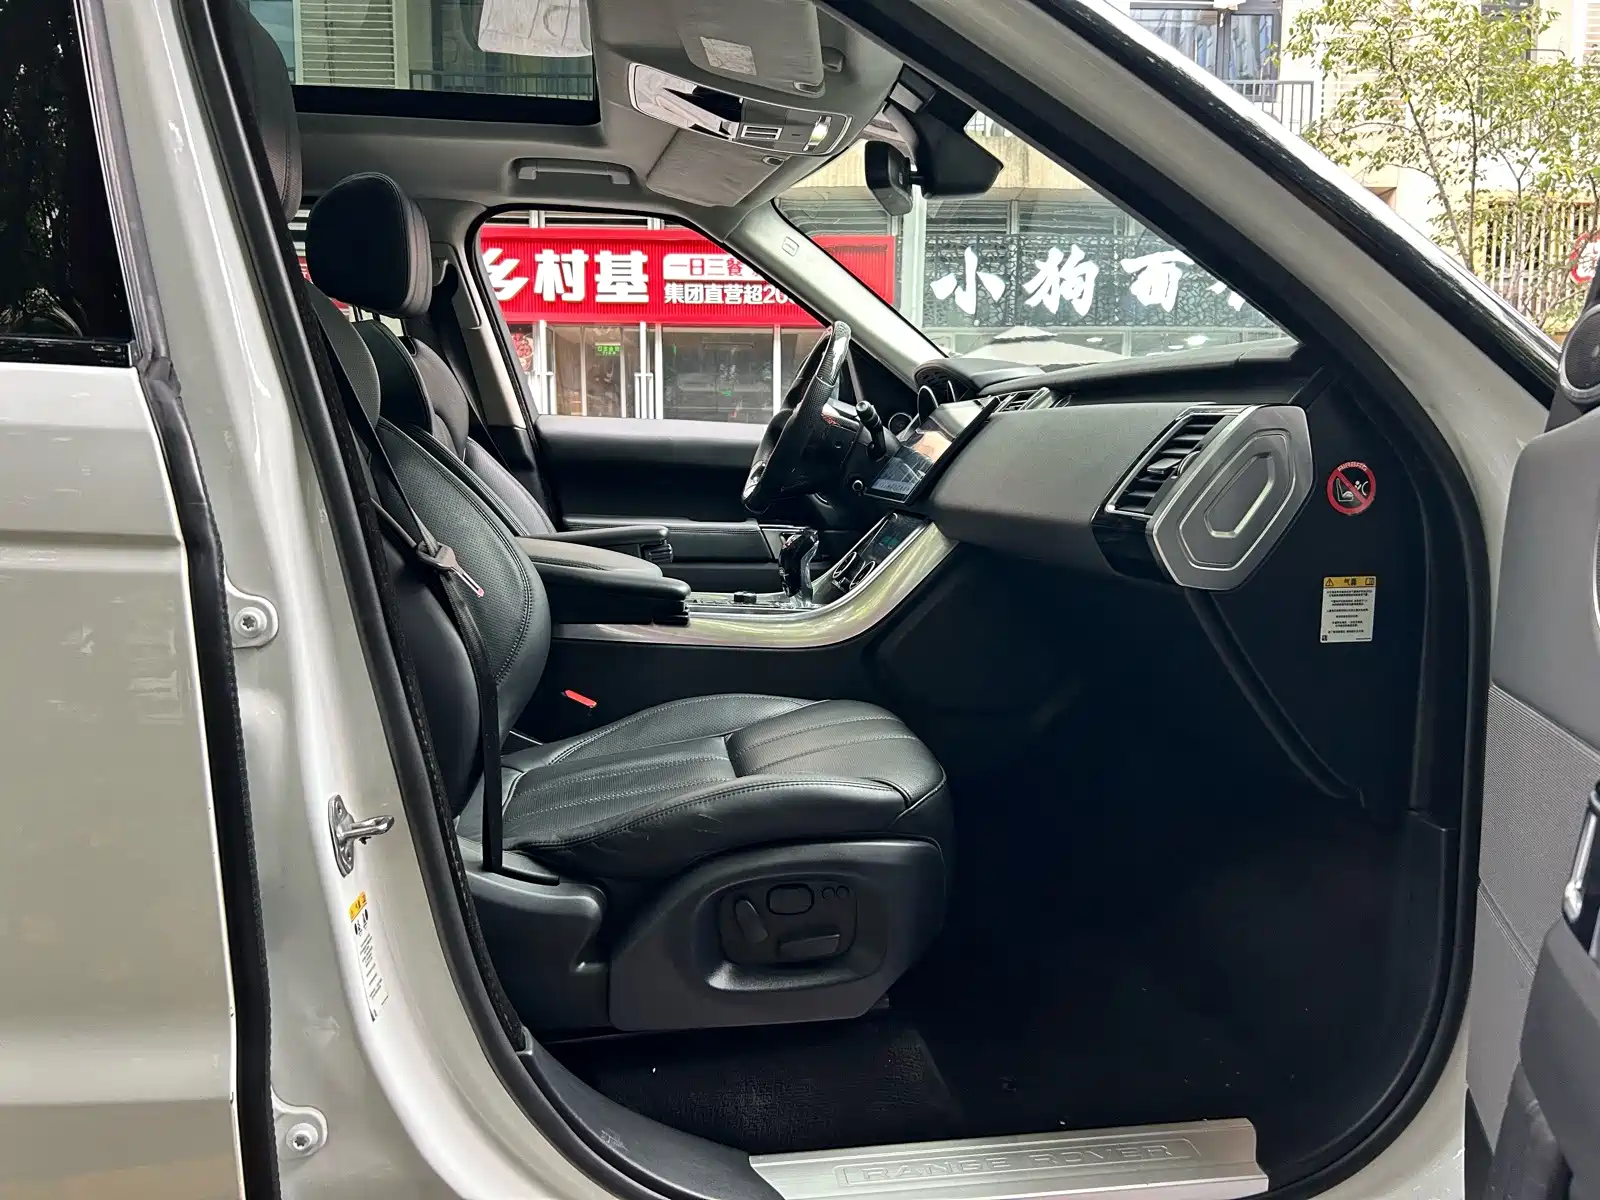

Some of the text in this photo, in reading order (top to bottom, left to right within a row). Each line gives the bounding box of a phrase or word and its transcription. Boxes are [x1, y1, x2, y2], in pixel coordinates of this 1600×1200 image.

[482, 247, 650, 304] 乡村基
[669, 257, 761, 277] 一日三餐
[664, 282, 796, 304] 集团直营超20
[862, 1145, 1173, 1181] RANGE ROVER
